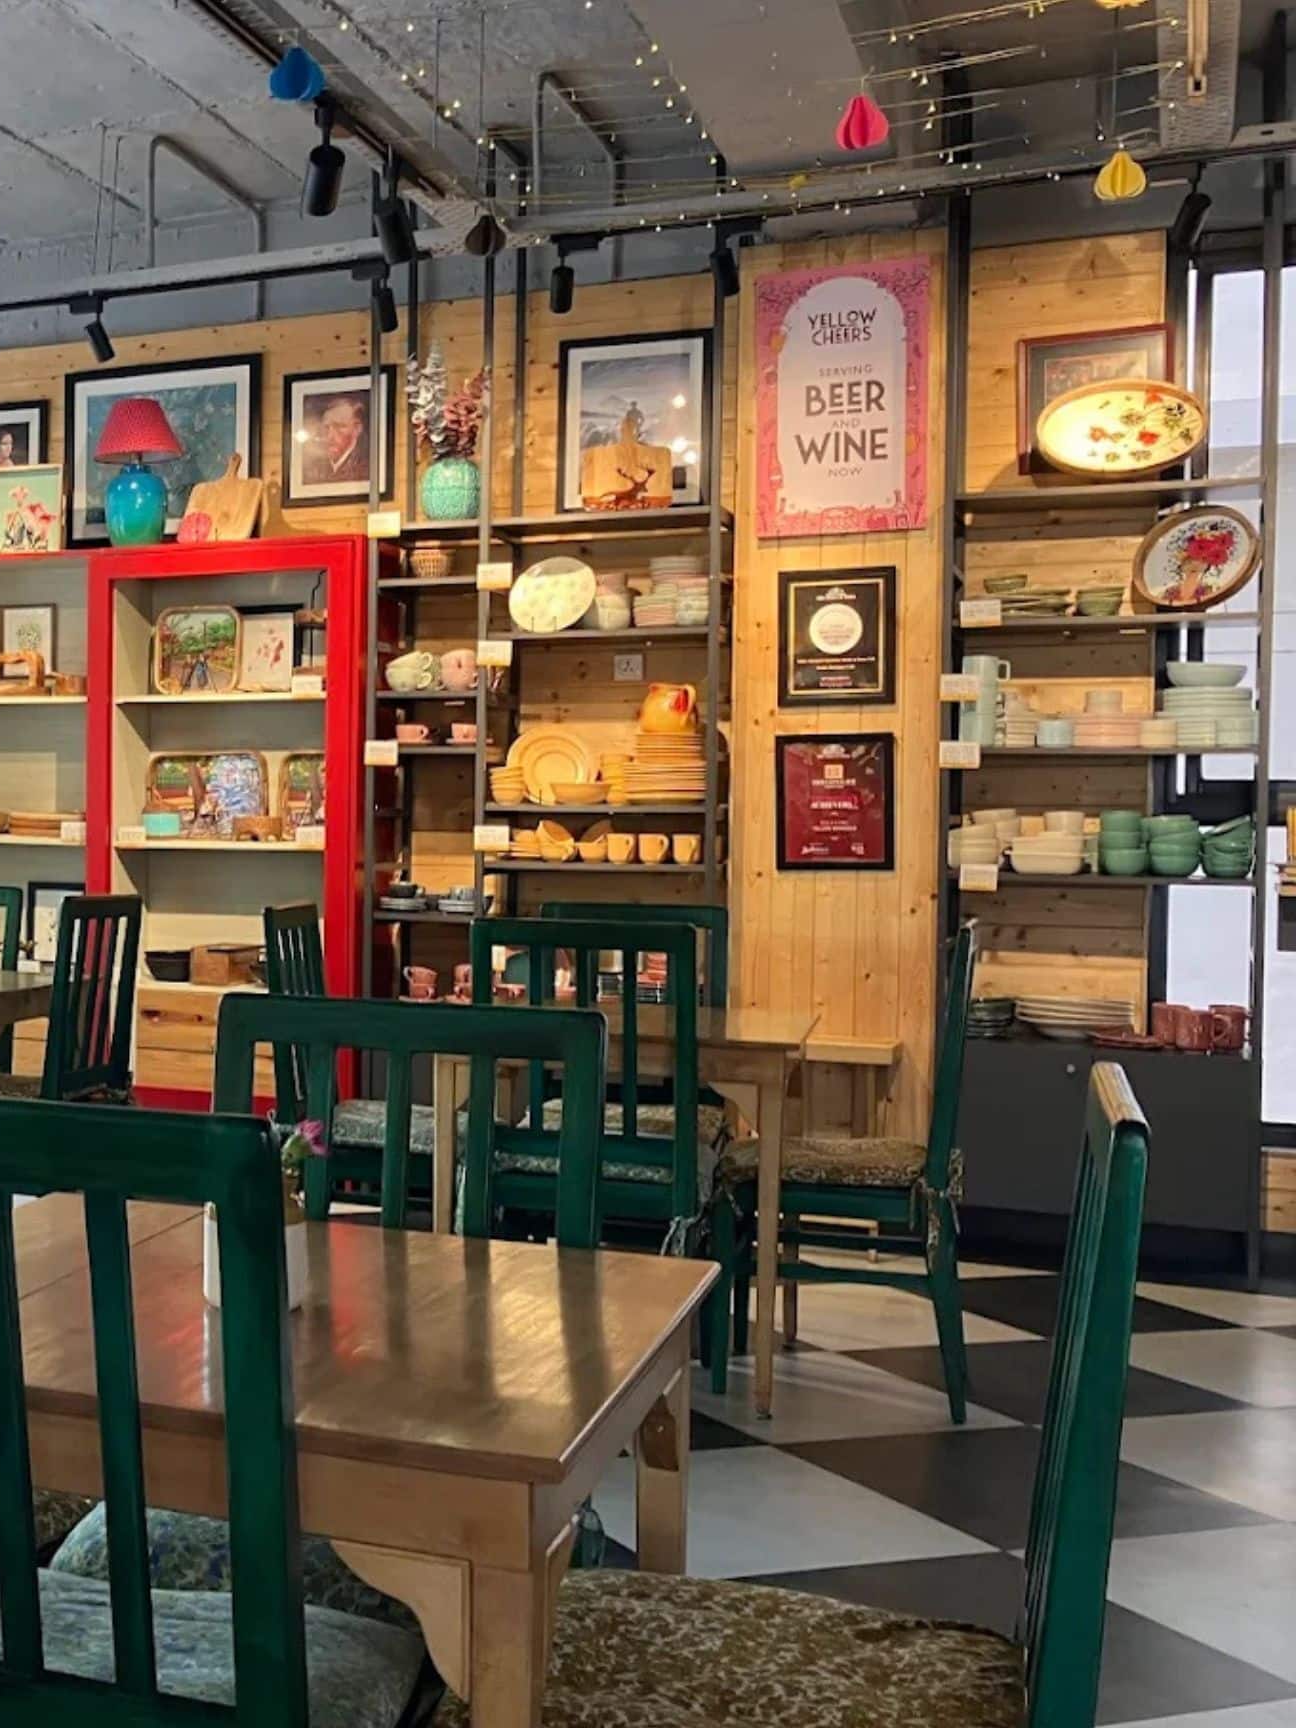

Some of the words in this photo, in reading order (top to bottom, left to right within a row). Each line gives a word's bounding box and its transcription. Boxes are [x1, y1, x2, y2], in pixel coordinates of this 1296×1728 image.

[808, 306, 877, 330] YELLOW
[811, 326, 873, 346] CHEERS
[819, 364, 873, 377] SERVING
[805, 379, 886, 417] BEER
[831, 417, 861, 429] AND
[794, 428, 888, 464] WINE
[828, 467, 864, 478] NOW
